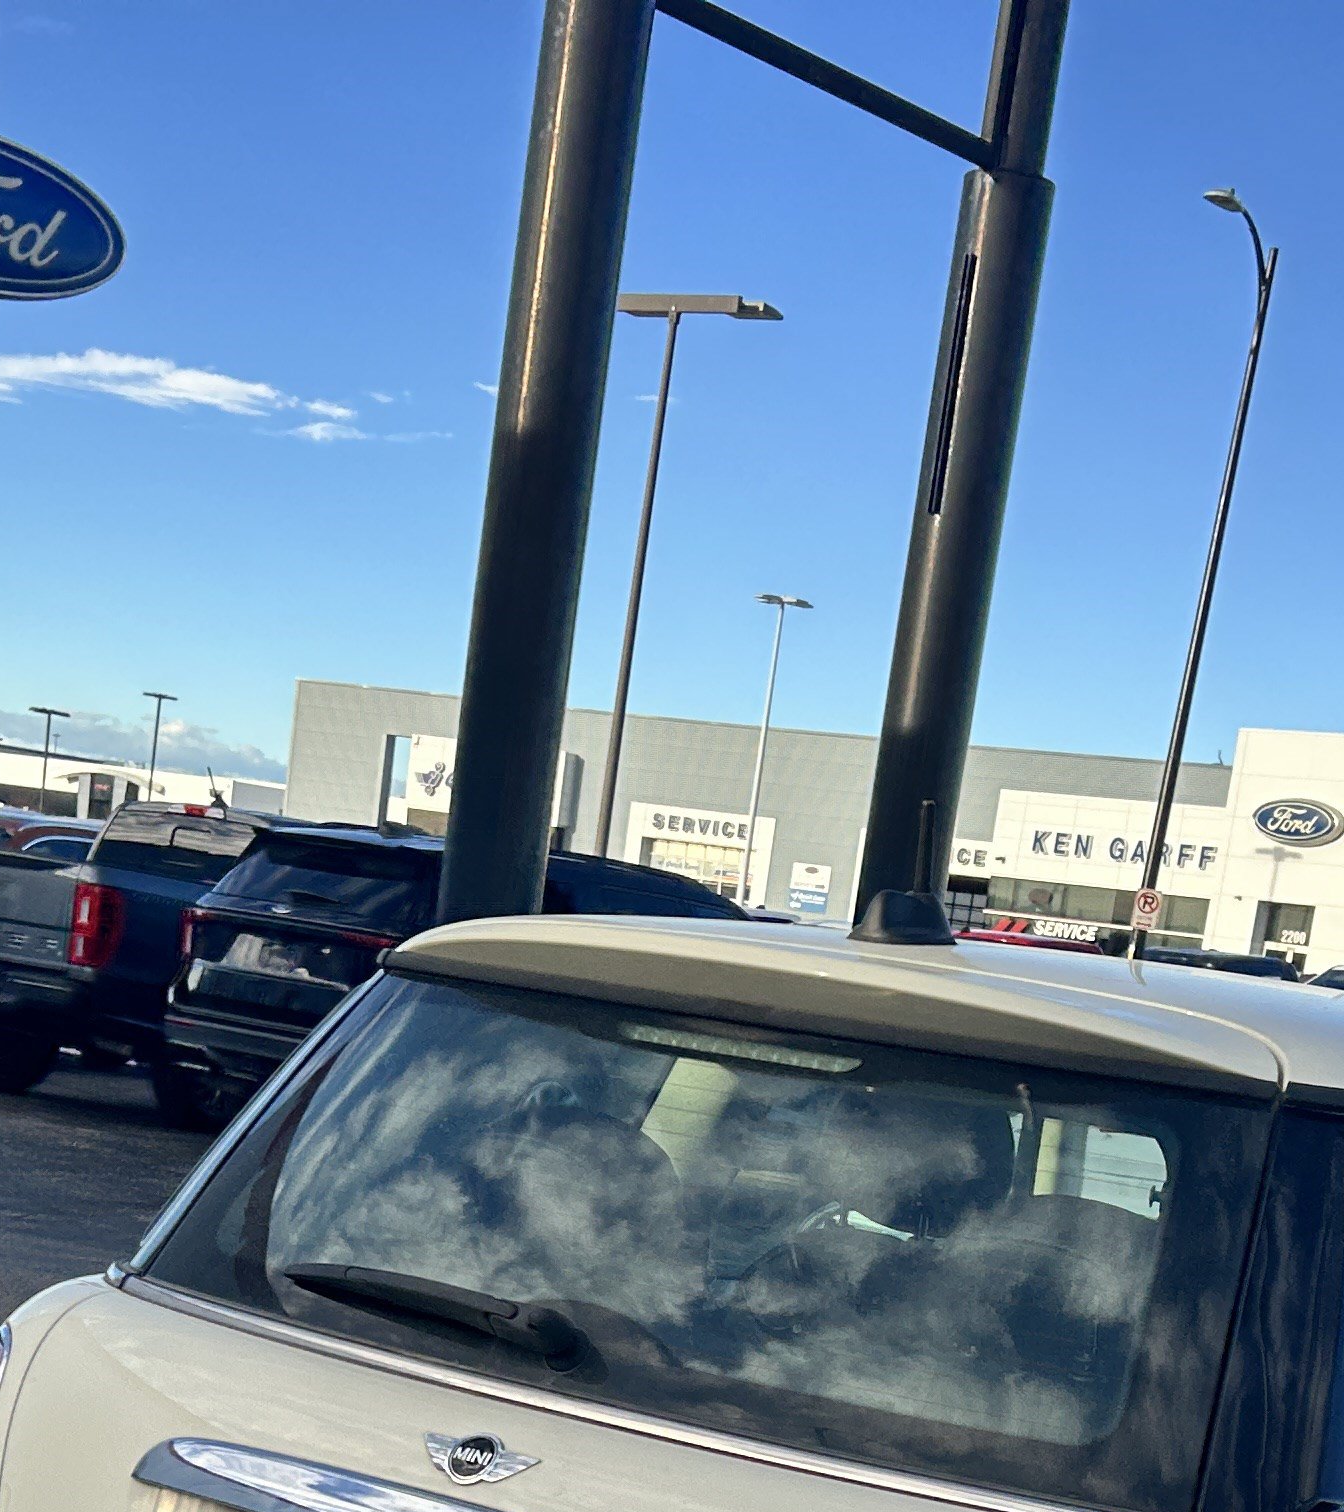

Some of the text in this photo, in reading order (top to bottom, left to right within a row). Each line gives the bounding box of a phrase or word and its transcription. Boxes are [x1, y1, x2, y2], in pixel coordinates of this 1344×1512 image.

[652, 812, 749, 841] SERVICE
[1266, 806, 1319, 834] Ford
[1031, 829, 1218, 871] KEN GARFF
[1032, 920, 1099, 942] SERVICE
[1280, 929, 1307, 945] 2200
[452, 1445, 493, 1466] MINI
